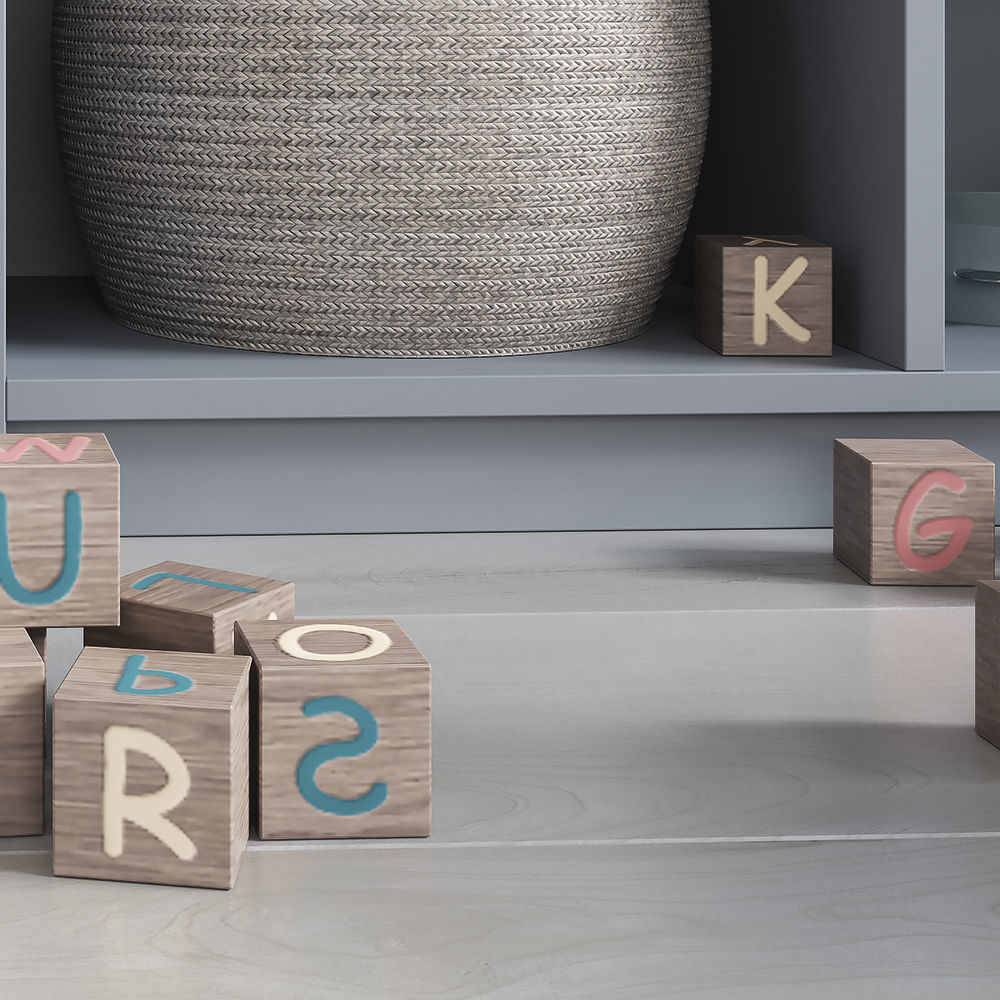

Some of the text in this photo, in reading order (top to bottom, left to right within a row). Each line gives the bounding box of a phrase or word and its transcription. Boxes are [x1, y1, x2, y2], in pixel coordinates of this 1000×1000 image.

[754, 255, 811, 345] K
[894, 470, 974, 572] G
[277, 623, 393, 661] O
[103, 725, 198, 861] R
